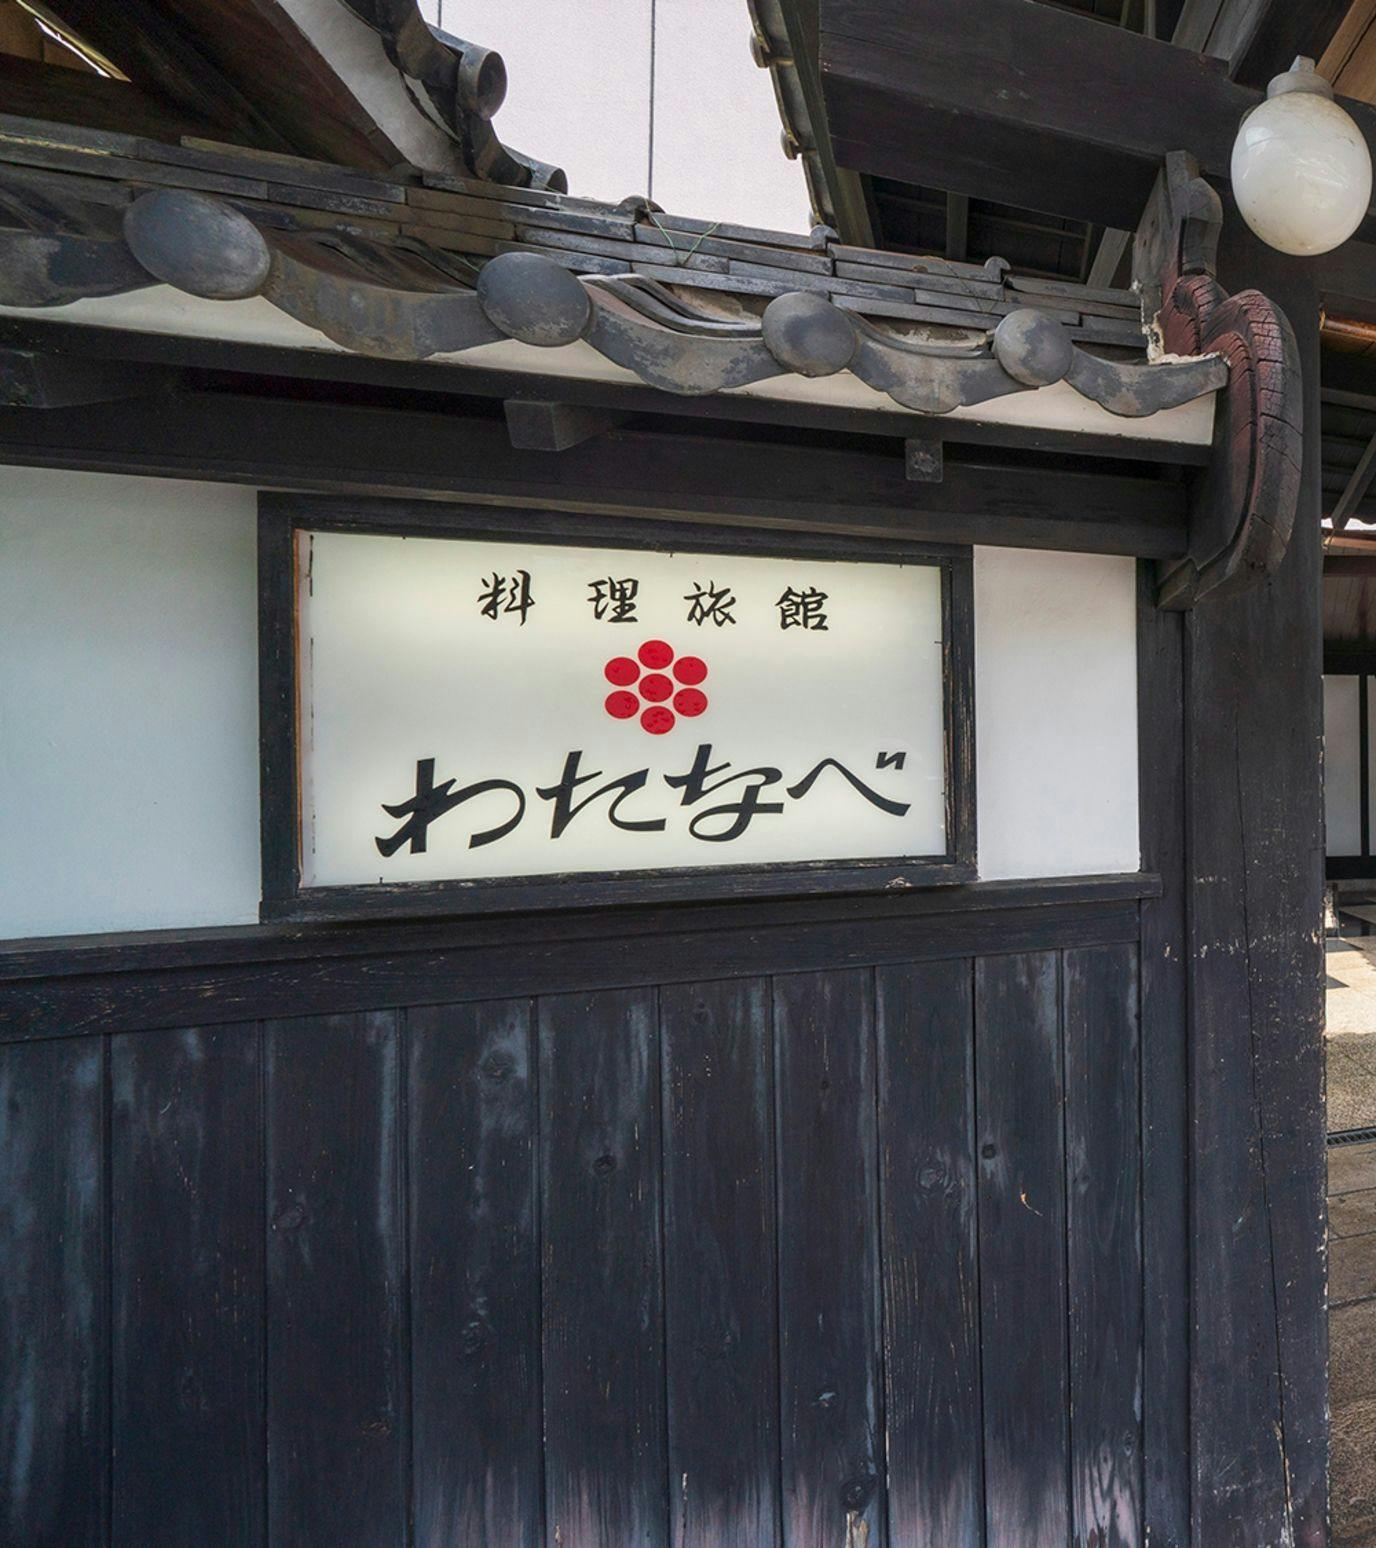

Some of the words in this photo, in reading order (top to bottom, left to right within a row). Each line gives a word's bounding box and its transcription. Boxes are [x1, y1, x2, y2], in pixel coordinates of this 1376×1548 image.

[477, 570, 829, 631] 料理旅館
[374, 743, 911, 858] わたなべ
